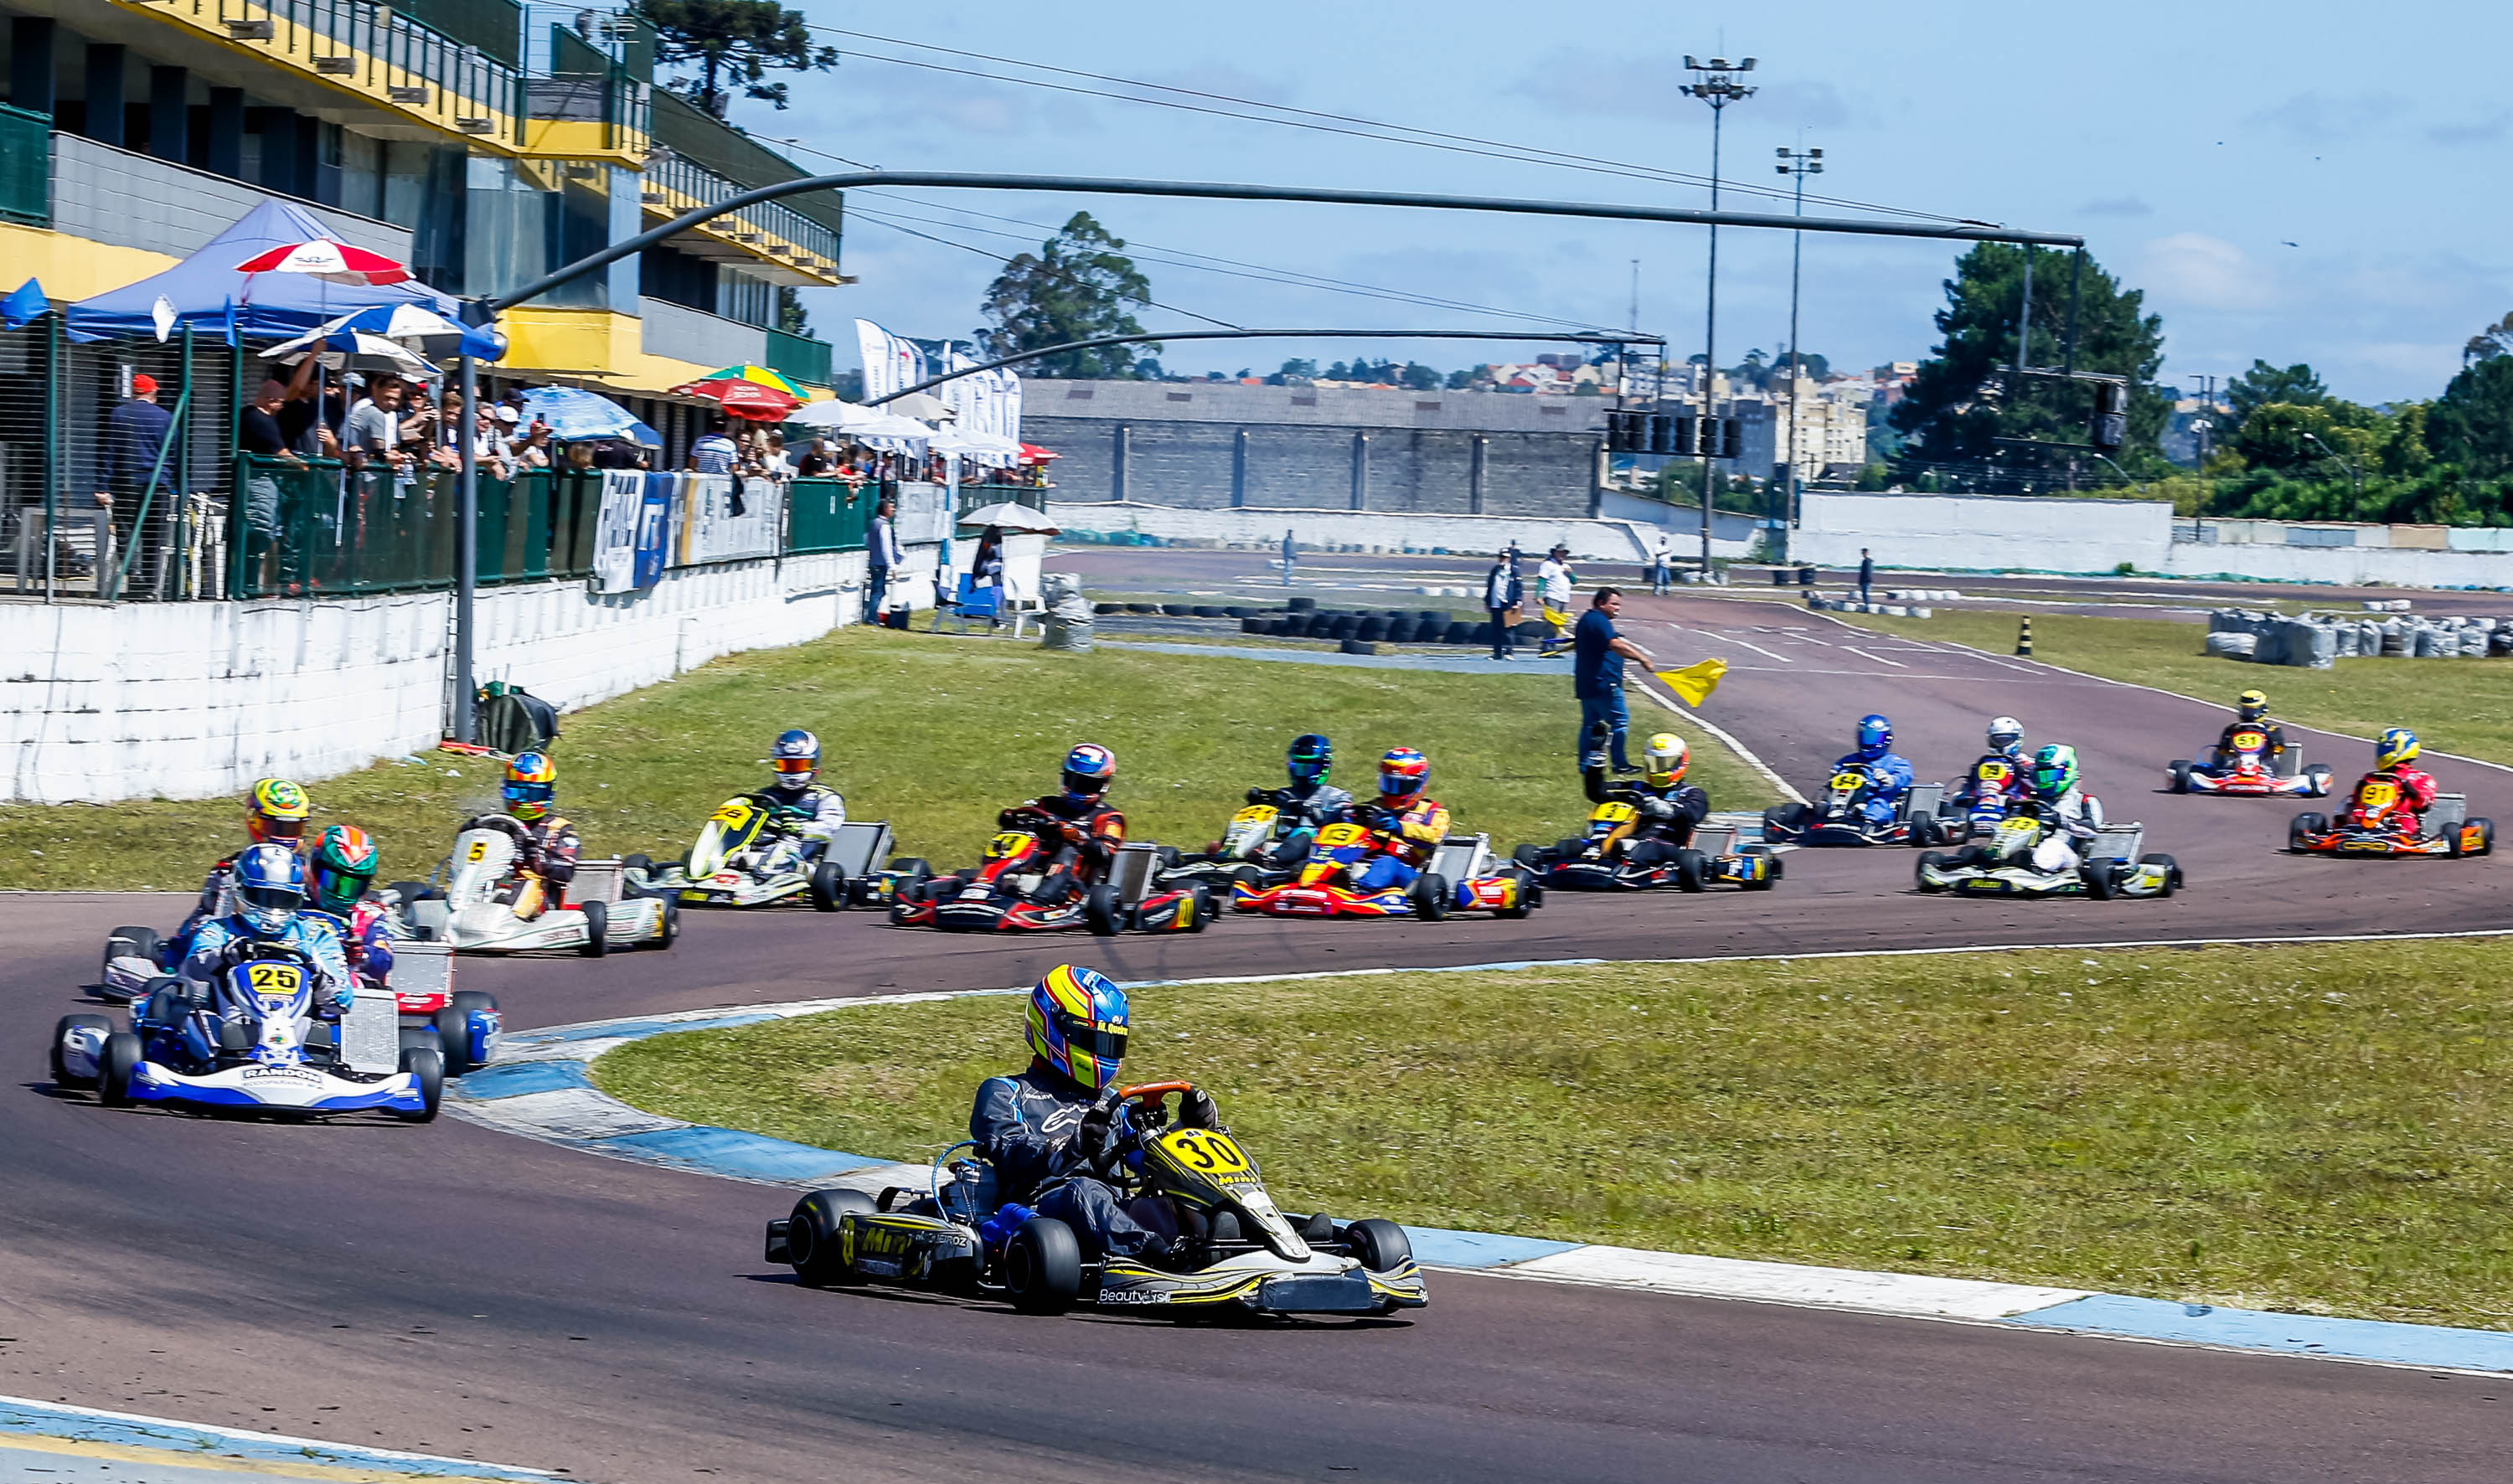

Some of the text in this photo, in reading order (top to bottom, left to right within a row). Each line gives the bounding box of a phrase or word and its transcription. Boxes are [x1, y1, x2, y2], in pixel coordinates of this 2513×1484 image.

[469, 842, 486, 861] 5
[255, 970, 296, 988] 25
[1097, 1021, 1107, 1033] M.
[1176, 1136, 1241, 1169] 30
